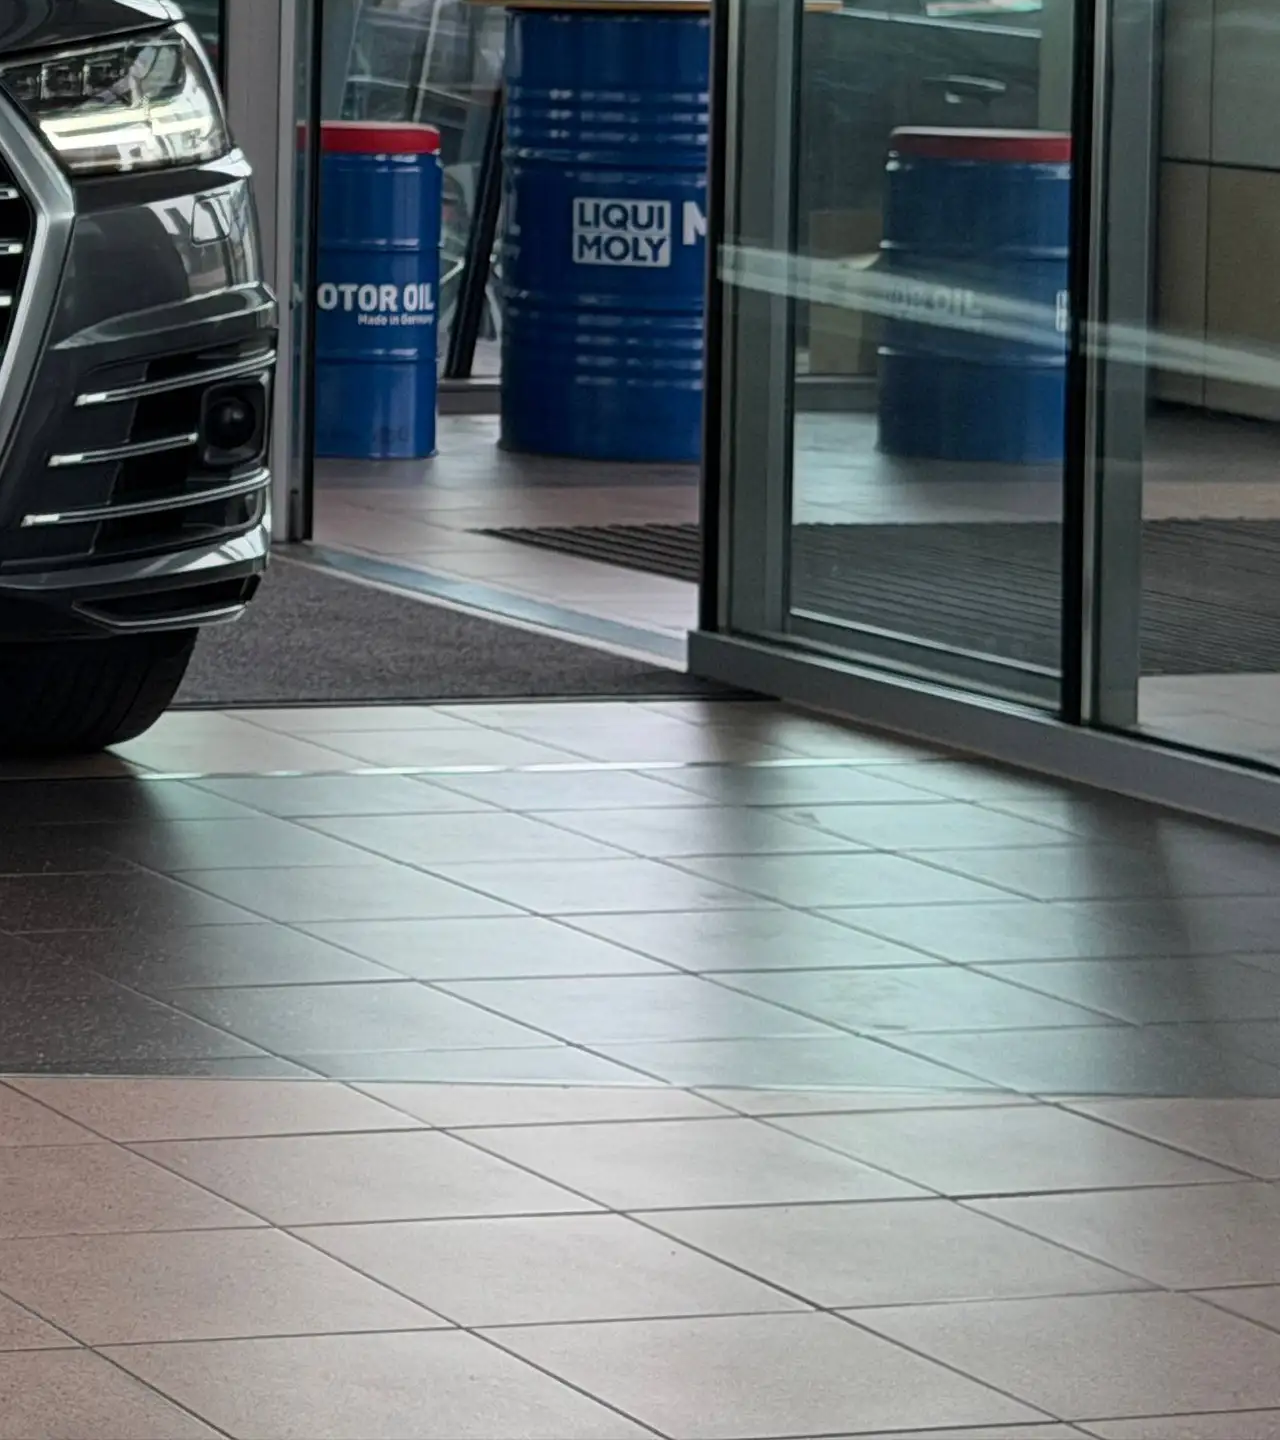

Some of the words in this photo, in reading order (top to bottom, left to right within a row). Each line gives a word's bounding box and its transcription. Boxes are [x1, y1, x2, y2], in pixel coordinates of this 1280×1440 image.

[578, 202, 665, 231] LIQUI
[578, 234, 667, 262] MOLY
[403, 282, 435, 312] OIL
